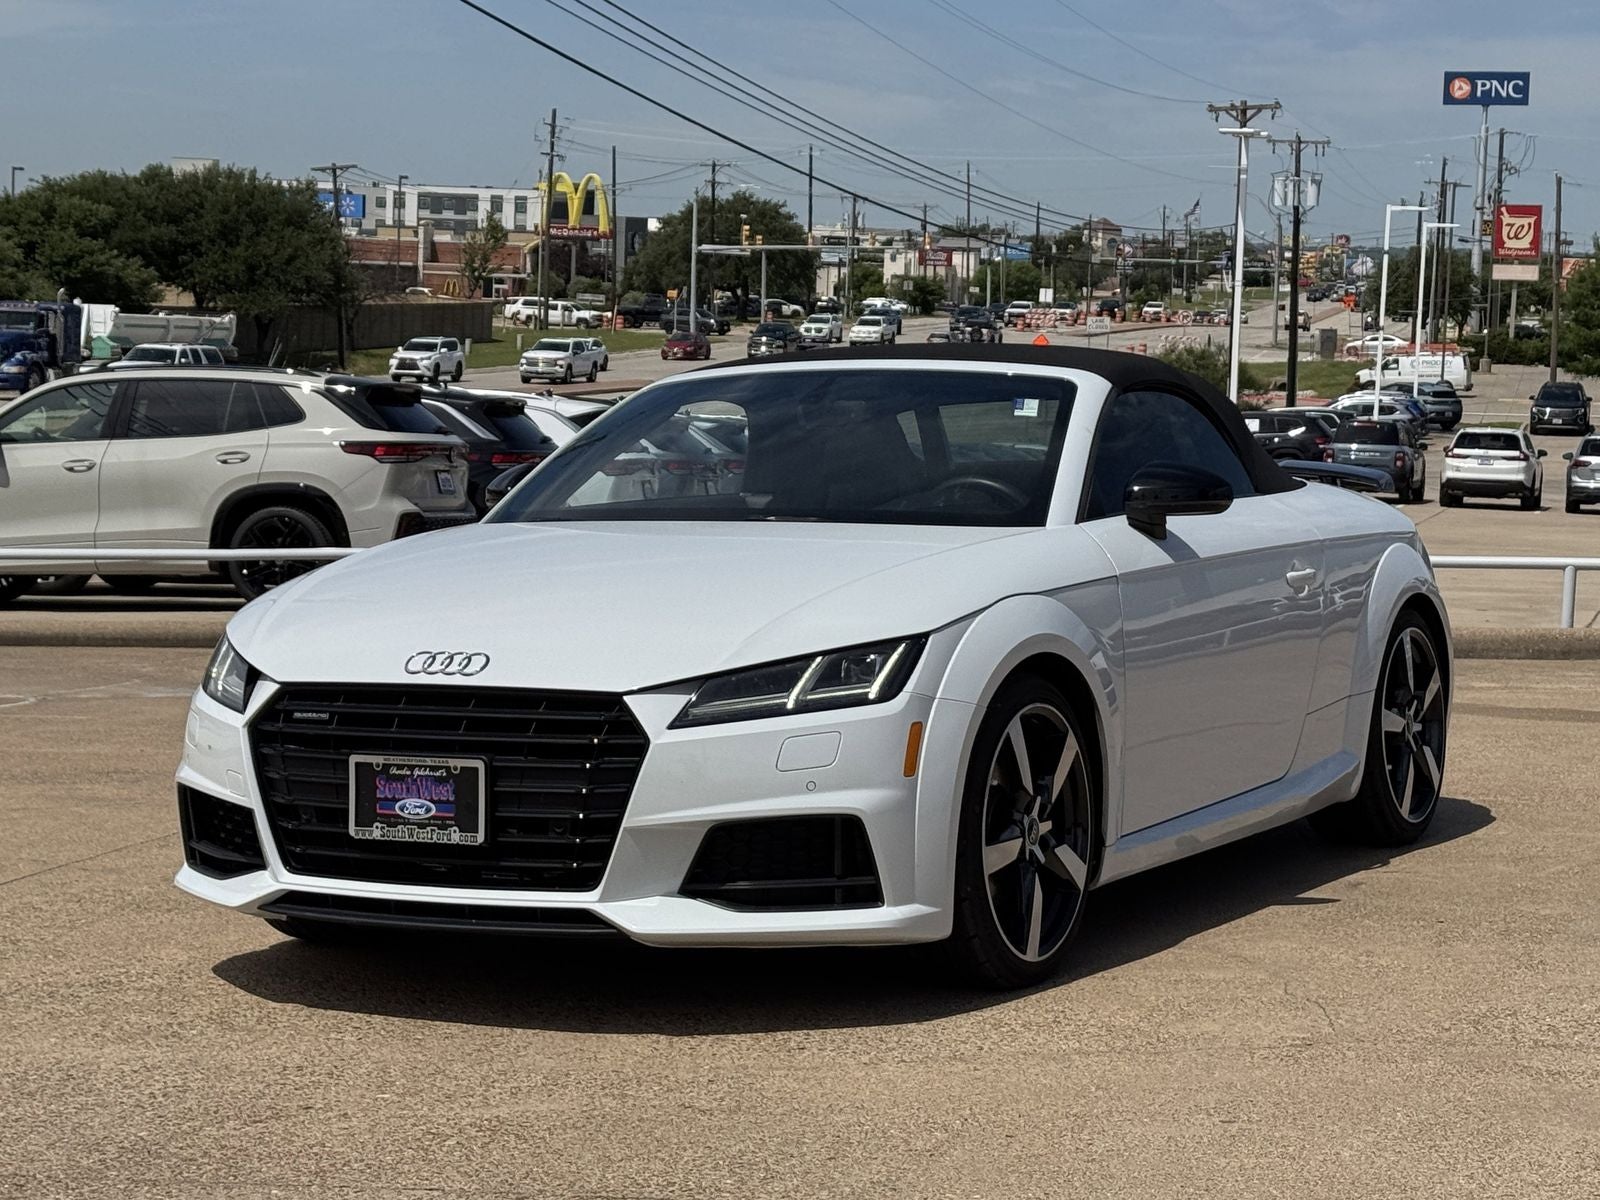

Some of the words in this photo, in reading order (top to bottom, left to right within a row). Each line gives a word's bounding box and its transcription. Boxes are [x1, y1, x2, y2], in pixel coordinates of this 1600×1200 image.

[1475, 79, 1524, 98] PNC
[549, 227, 598, 237] McDonald's
[1497, 247, 1536, 257] Walgreens
[376, 775, 456, 800] SouthWest
[403, 801, 427, 815] Ford
